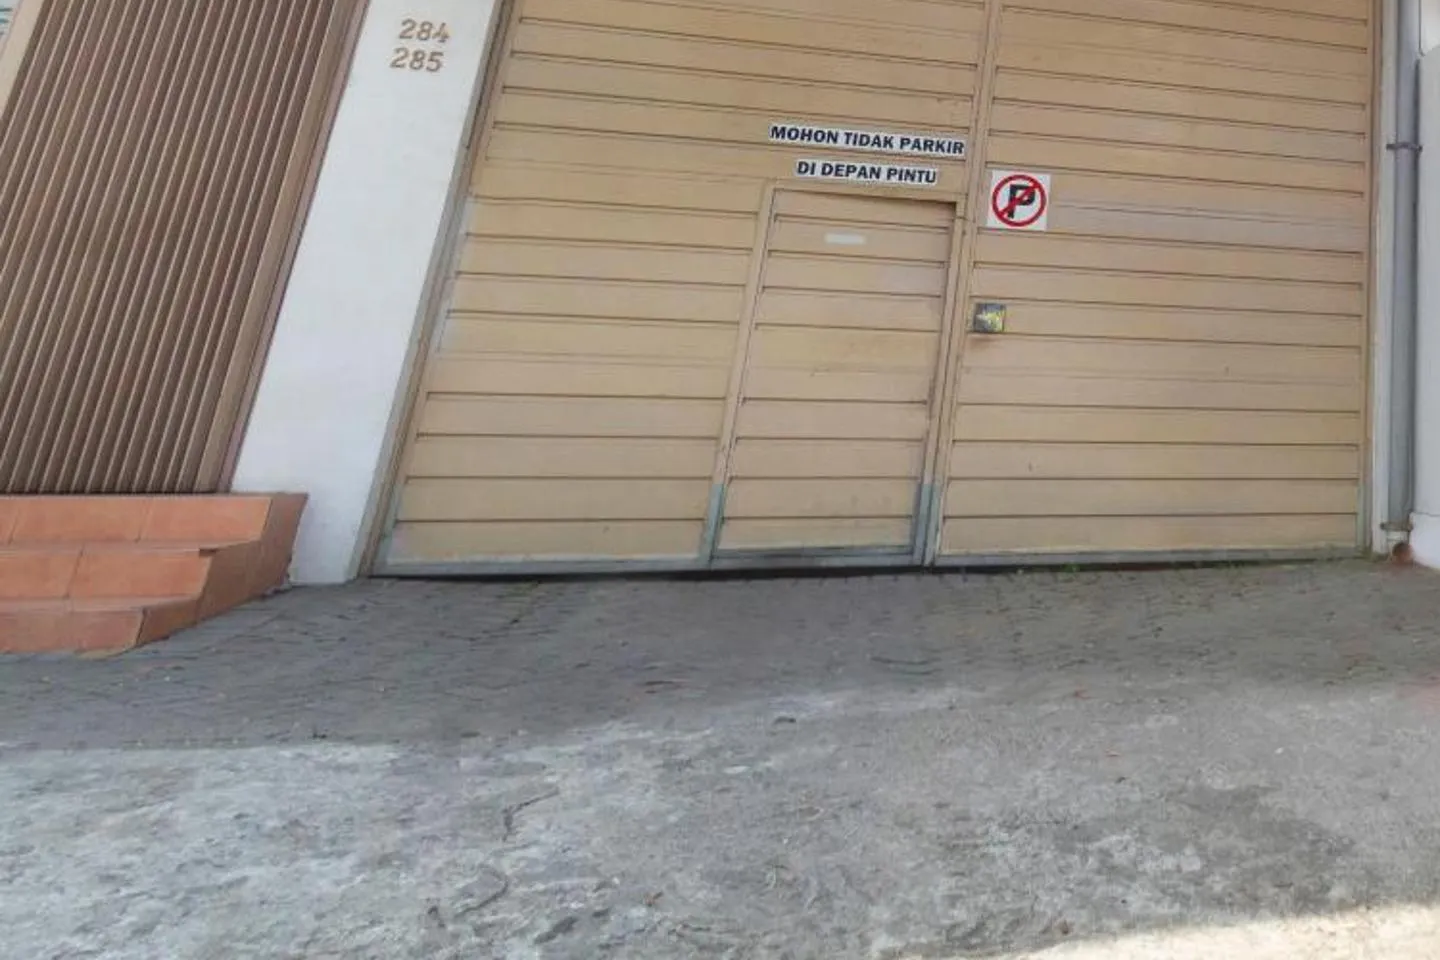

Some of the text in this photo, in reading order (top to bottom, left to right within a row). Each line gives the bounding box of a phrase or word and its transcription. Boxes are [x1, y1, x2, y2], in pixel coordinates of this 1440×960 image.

[399, 18, 450, 43] 284
[390, 47, 444, 72] 285
[770, 126, 965, 154] MOHON TIDAK PARKIR
[797, 161, 937, 183] DI DEPAN PINTU
[1007, 184, 1036, 219] P
